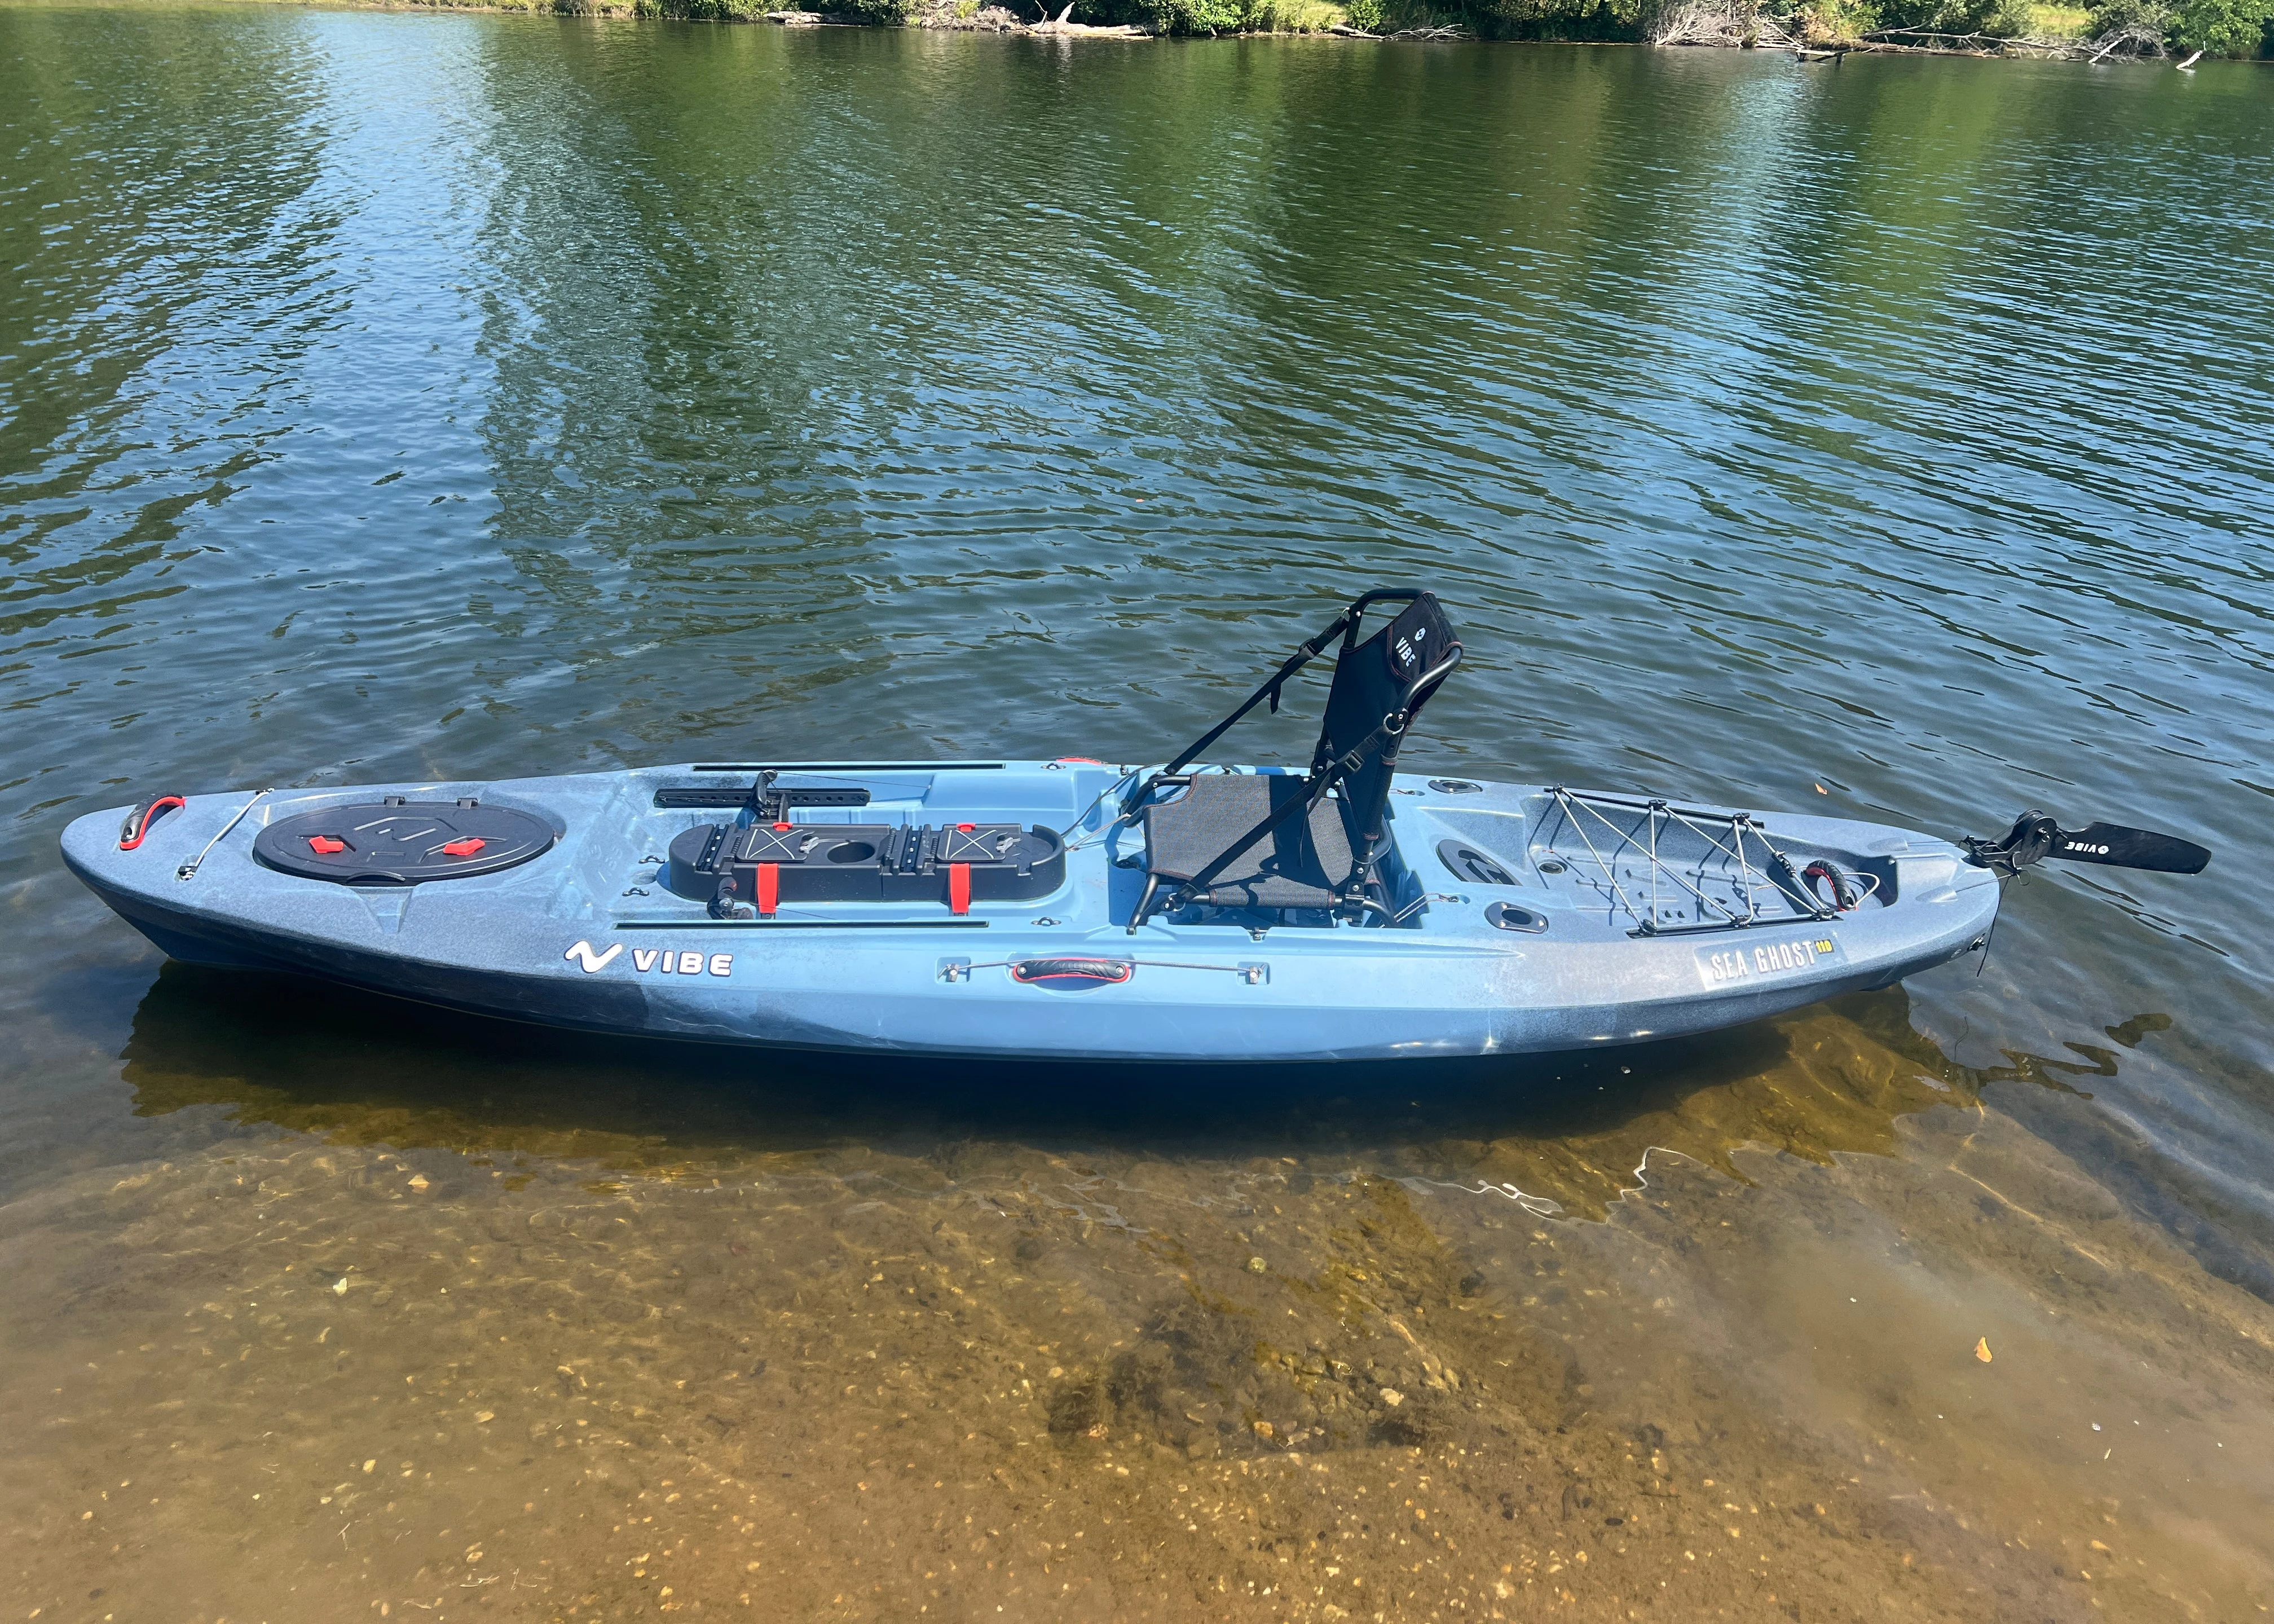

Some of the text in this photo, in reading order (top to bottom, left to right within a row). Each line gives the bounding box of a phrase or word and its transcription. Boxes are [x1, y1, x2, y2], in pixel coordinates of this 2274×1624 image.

[1395, 637, 1416, 667] VIBE
[2064, 841, 2096, 853] VIBE
[632, 948, 733, 977] VIBE
[1711, 939, 1832, 981] SEA GHOST 110
